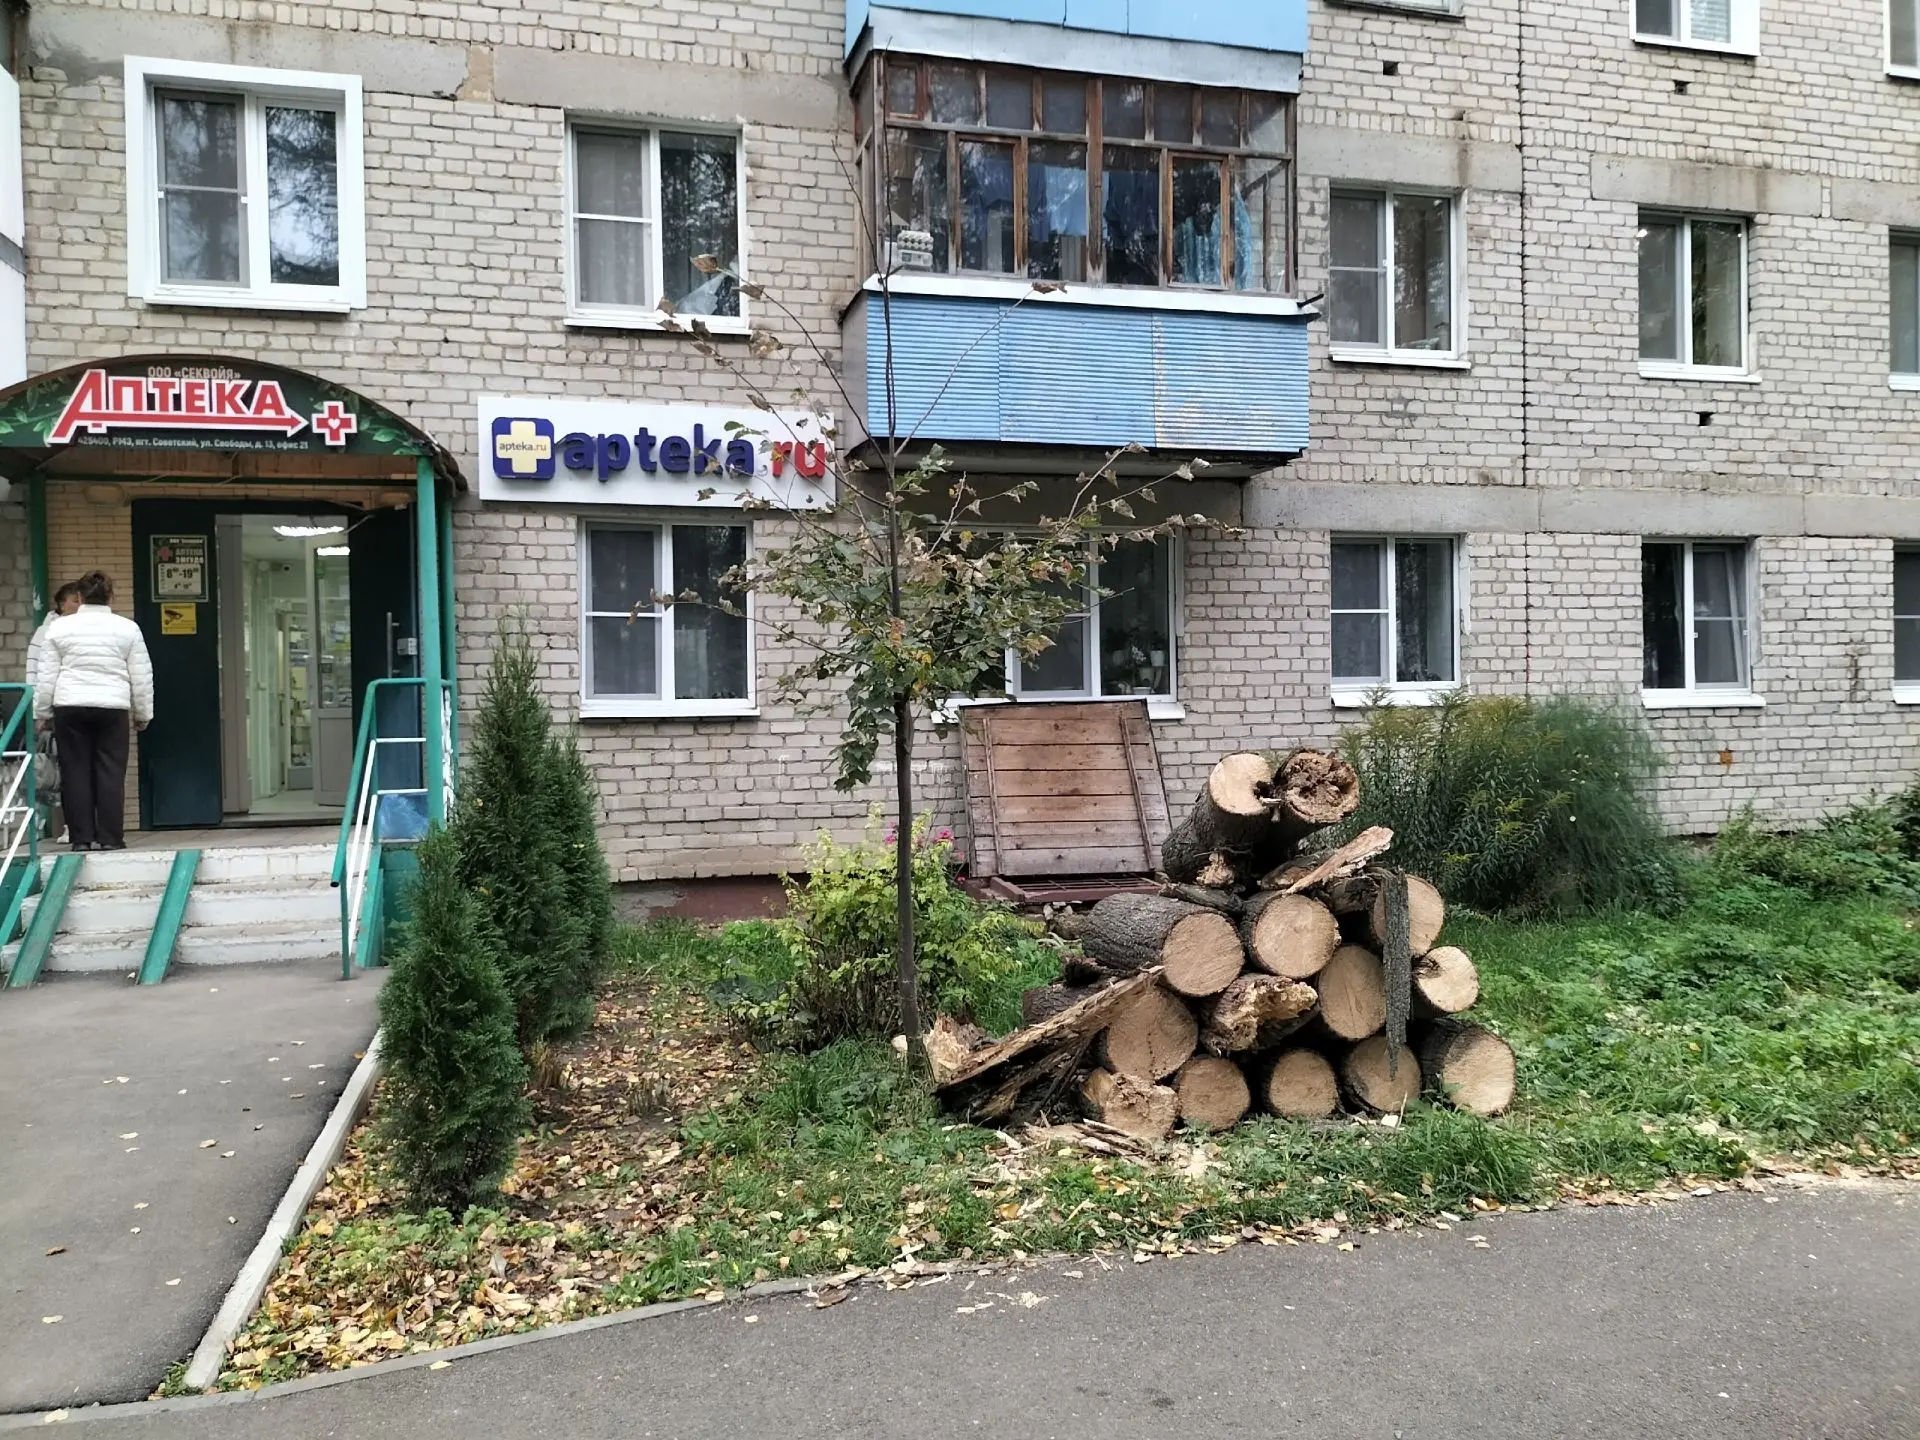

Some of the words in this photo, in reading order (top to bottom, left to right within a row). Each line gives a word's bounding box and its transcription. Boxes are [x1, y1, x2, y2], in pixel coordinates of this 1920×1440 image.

[148, 366, 171, 378] ООО
[174, 365, 241, 380] «СЕКВОЙЯ»
[49, 369, 300, 444] АПТЕКА
[499, 441, 548, 453] apteka.ru
